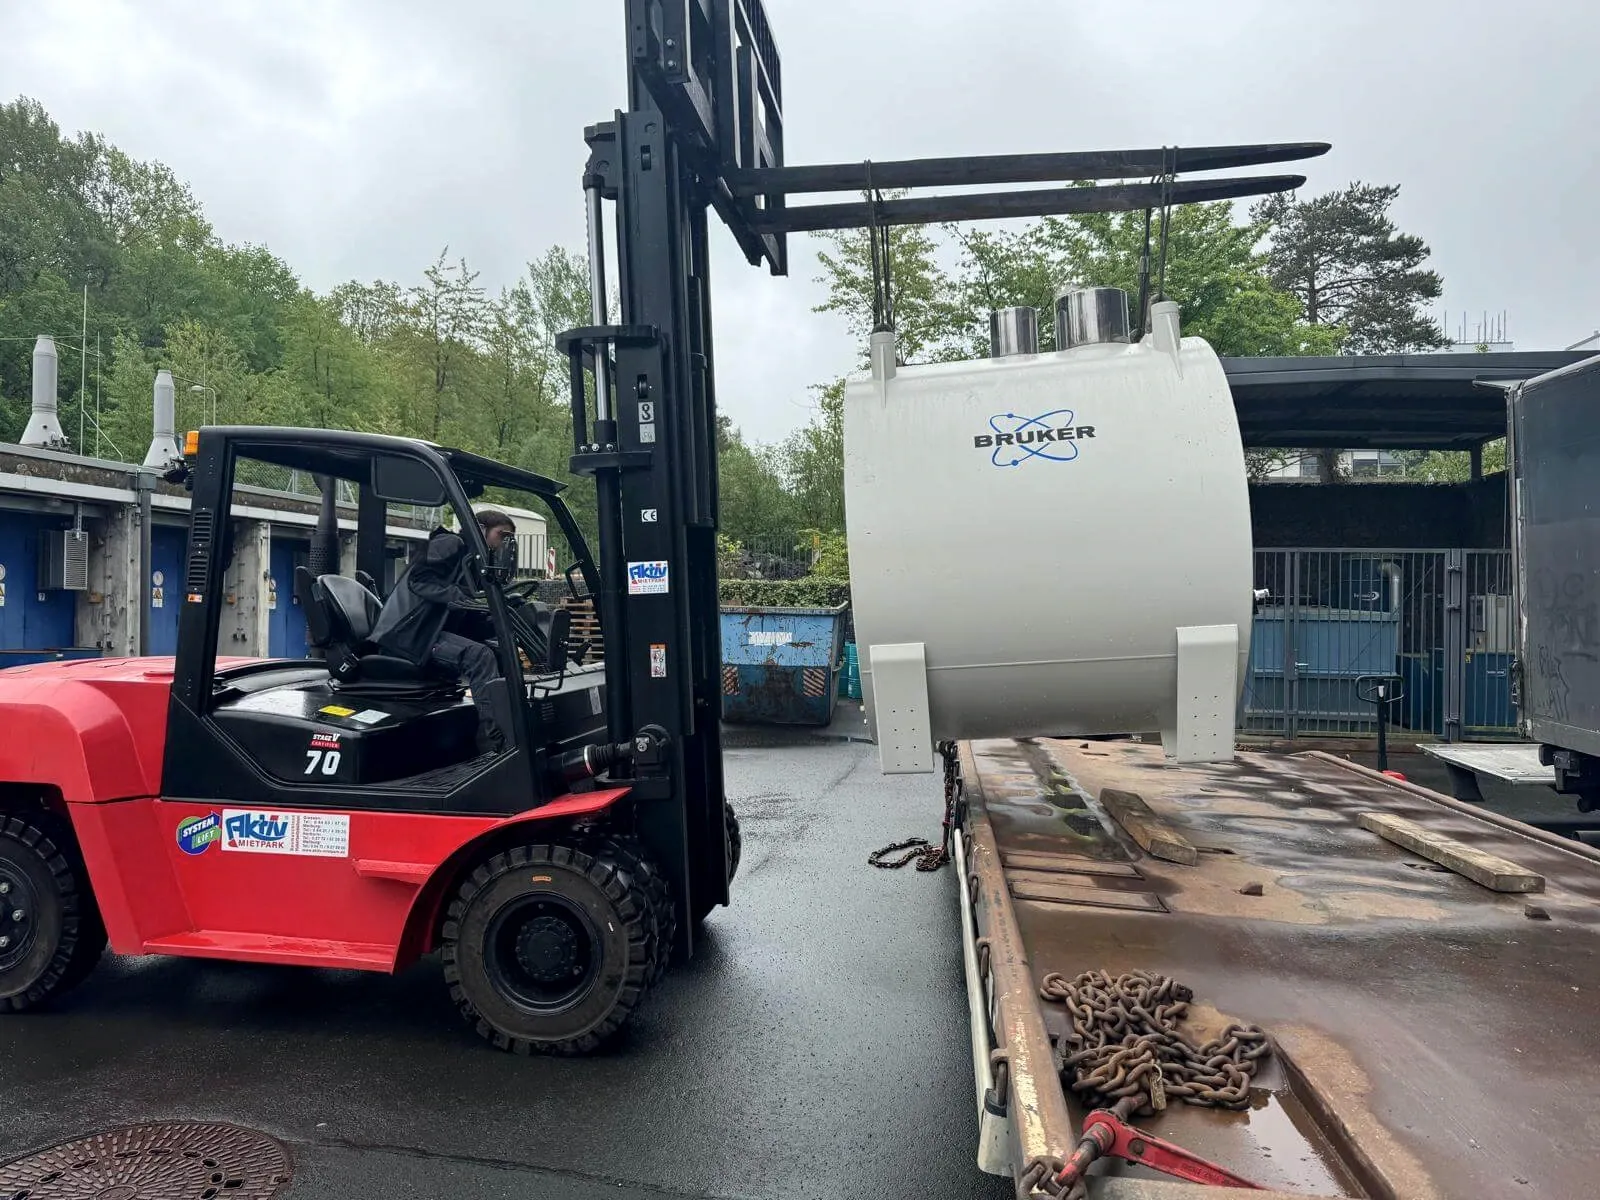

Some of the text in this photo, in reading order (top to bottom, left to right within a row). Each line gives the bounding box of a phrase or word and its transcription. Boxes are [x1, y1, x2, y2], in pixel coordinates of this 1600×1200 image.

[974, 425, 1096, 448] BRUKER
[642, 511, 657, 521] CE
[629, 563, 667, 579] Aktiv
[332, 733, 341, 742] V
[304, 750, 341, 775] 70
[182, 816, 215, 837] SYSTEM
[225, 813, 289, 842] Aktiv
[197, 829, 216, 844] LIFT
[238, 839, 285, 849] MIETPARK
